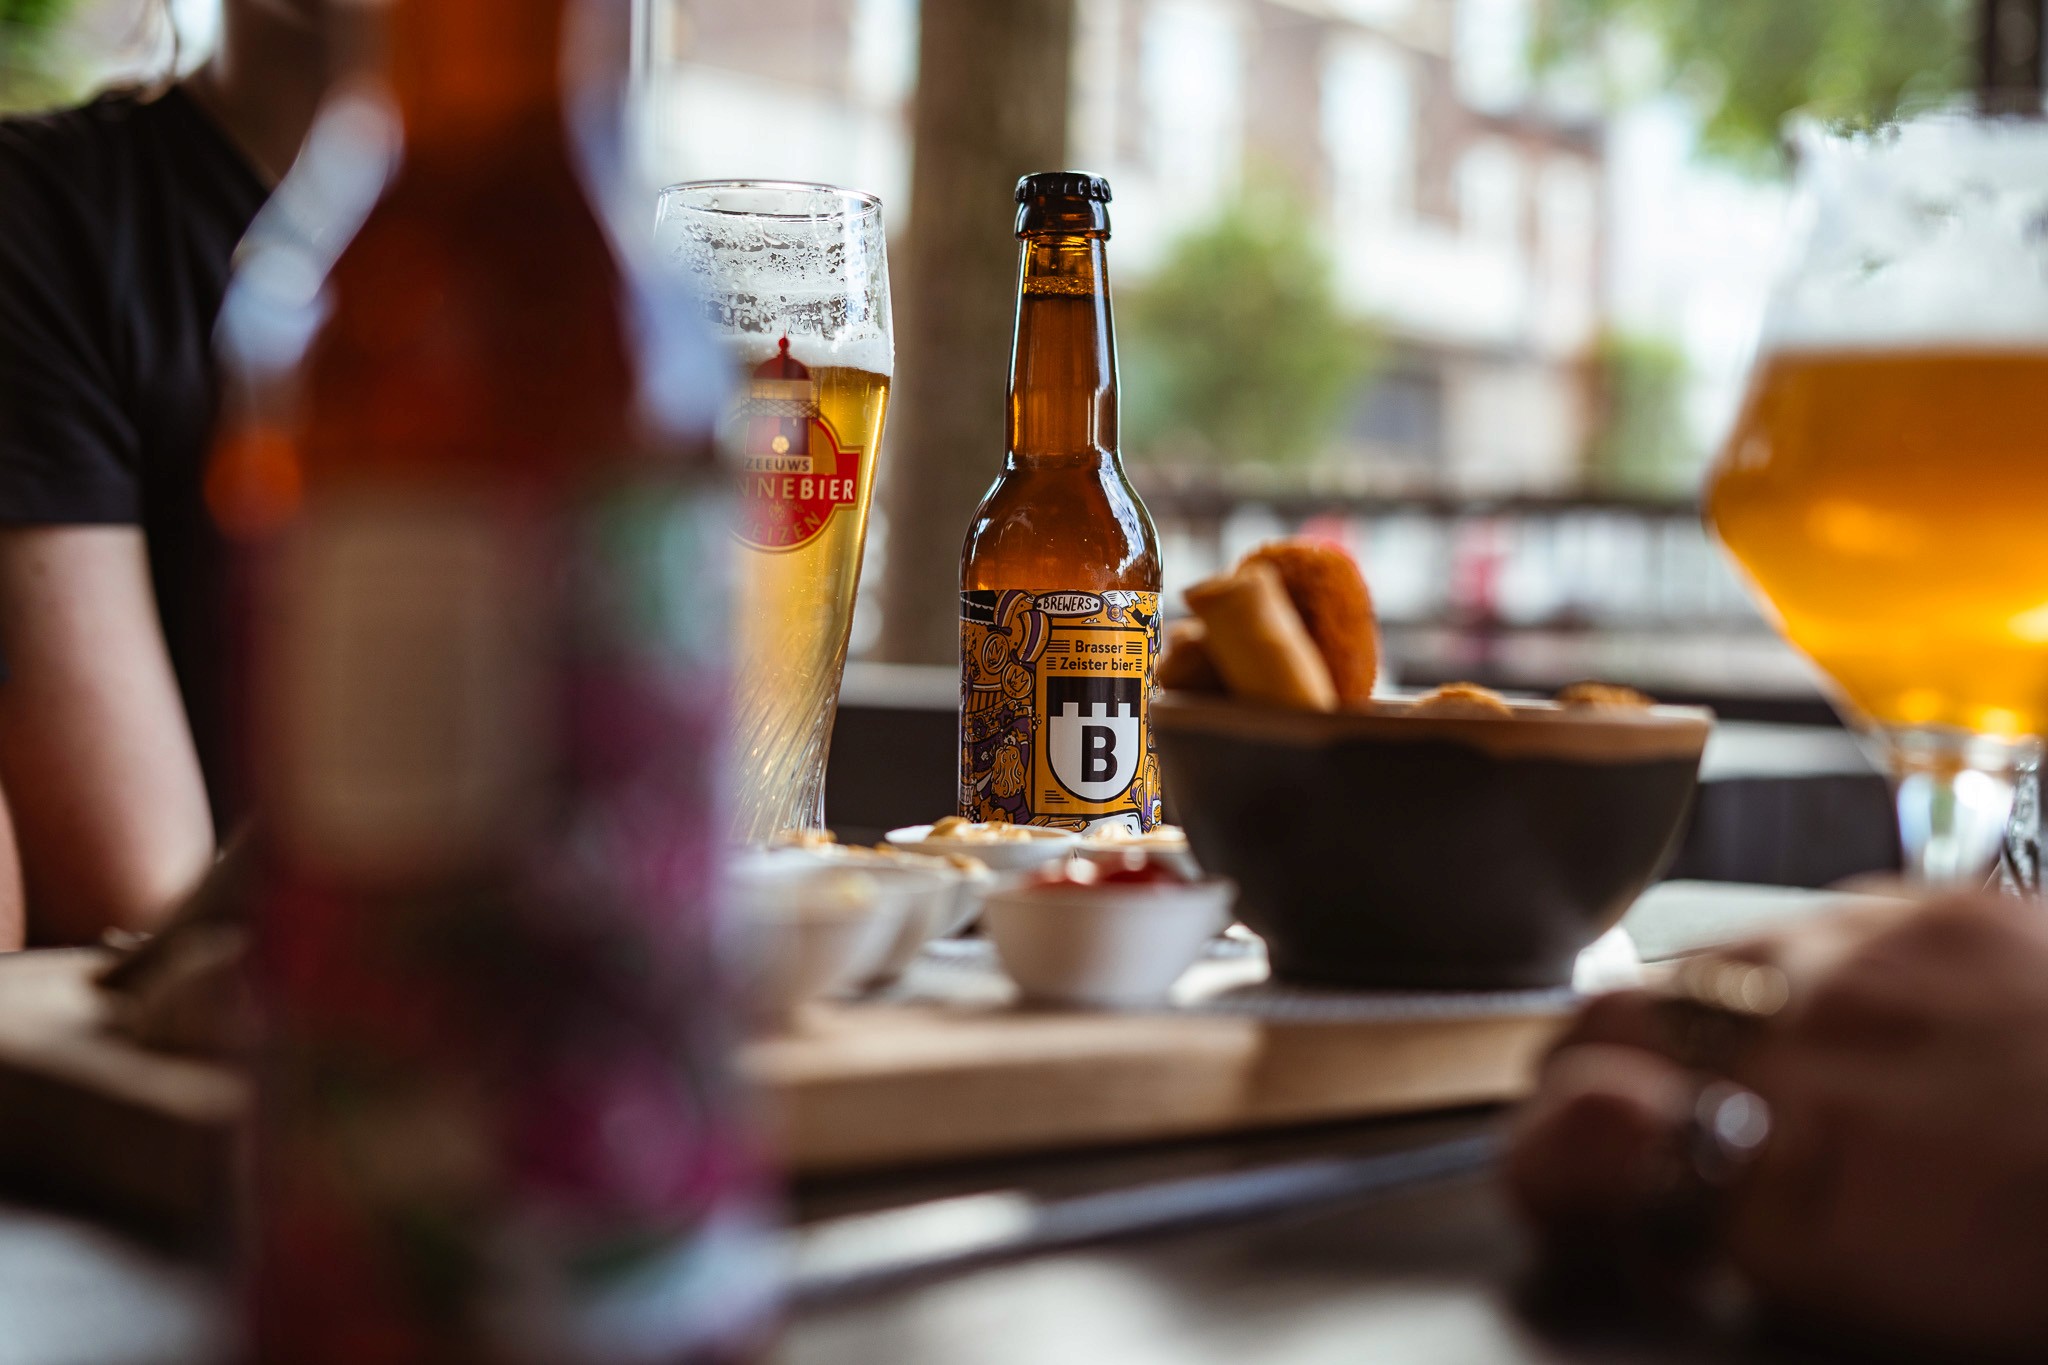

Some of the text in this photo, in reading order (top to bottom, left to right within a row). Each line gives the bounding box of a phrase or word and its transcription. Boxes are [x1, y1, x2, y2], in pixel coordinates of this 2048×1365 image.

[744, 458, 810, 472] ZEEUWS
[736, 477, 854, 500] NNEBIER
[1043, 597, 1092, 612] BREWERS
[1075, 640, 1123, 654] Brasser
[1060, 657, 1134, 671] Zeister bier
[1081, 725, 1118, 783] B
